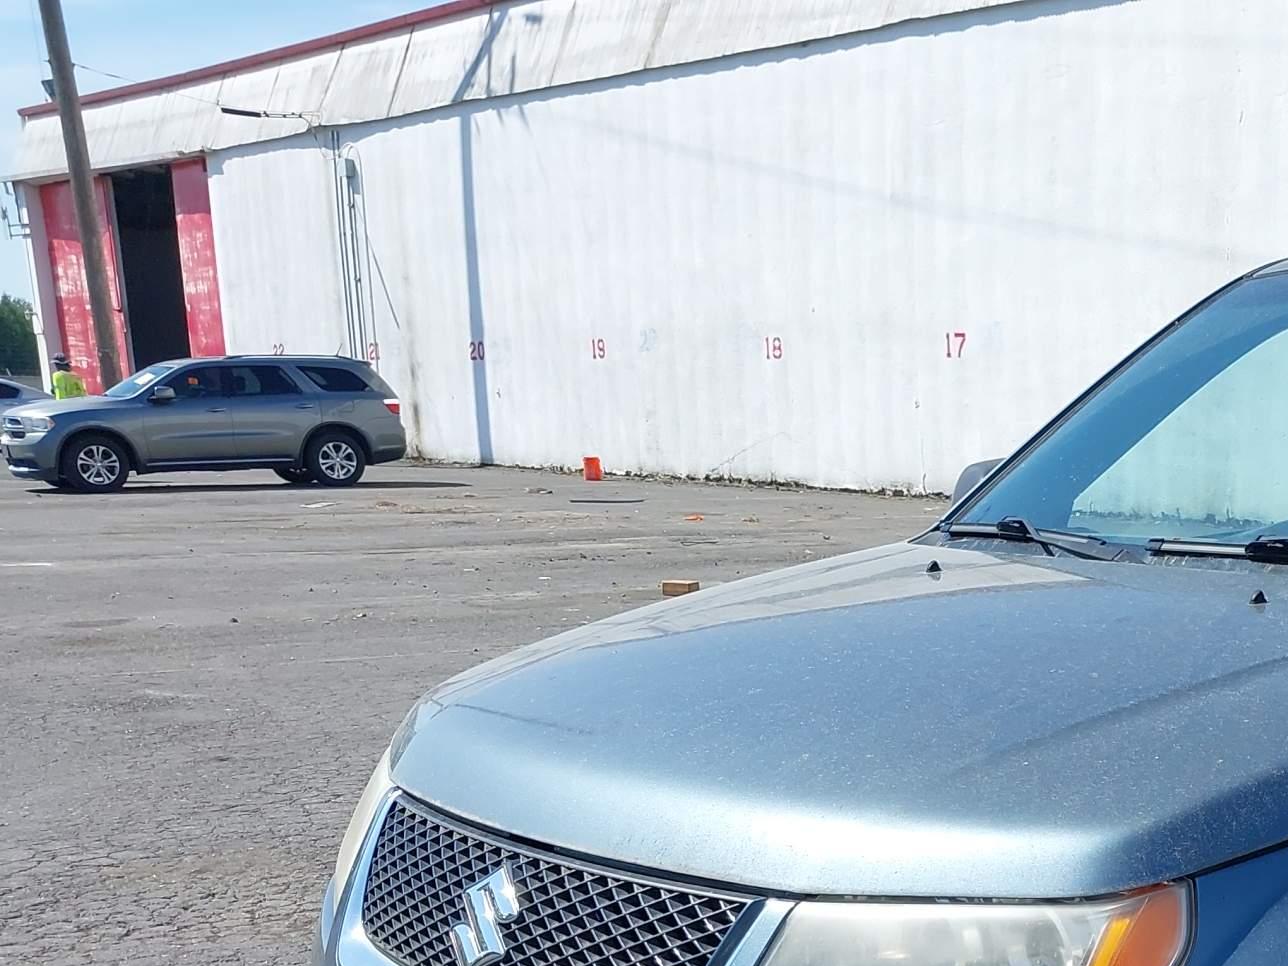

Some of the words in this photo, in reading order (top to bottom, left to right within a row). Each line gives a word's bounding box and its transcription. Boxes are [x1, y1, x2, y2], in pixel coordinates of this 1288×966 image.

[469, 340, 485, 361] 20
[591, 338, 606, 360] 19
[764, 335, 783, 360] 18
[945, 332, 966, 358] 17
